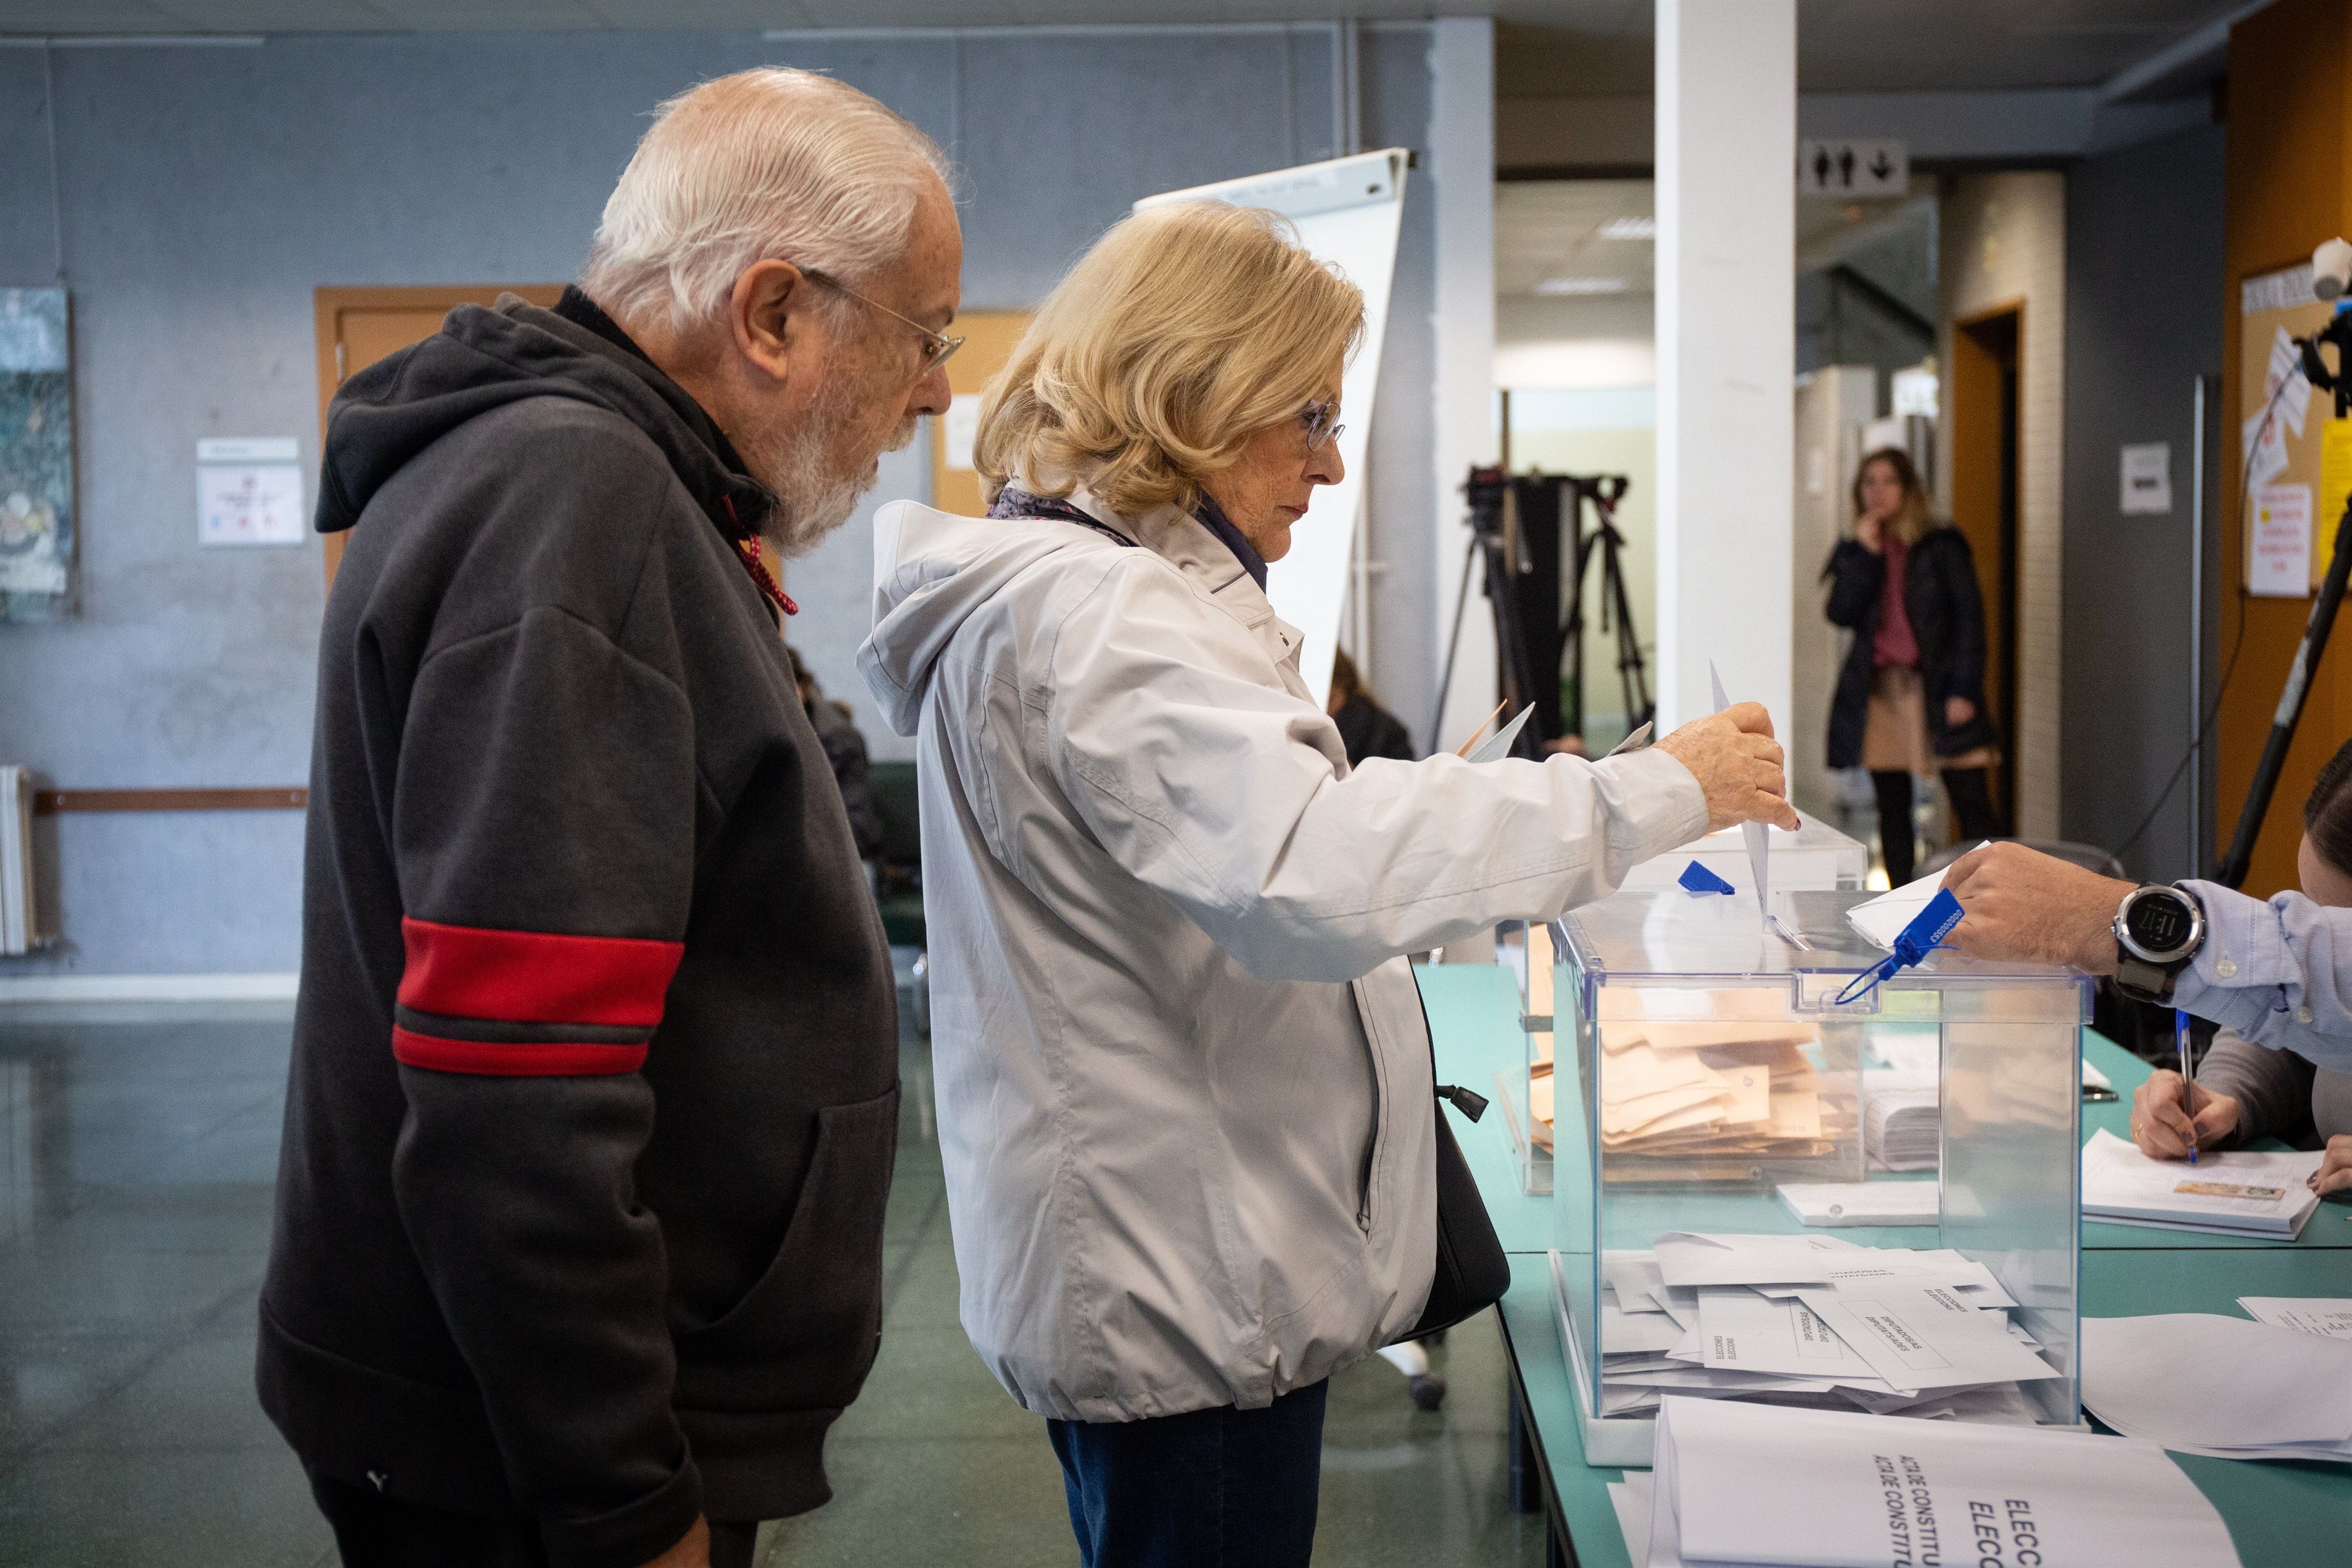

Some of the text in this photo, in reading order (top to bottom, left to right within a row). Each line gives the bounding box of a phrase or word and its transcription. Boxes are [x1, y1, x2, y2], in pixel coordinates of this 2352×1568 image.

[1930, 910, 1962, 943] 000200553
[1924, 1290, 1955, 1310] ELECCIONS
[1934, 1288, 1968, 1312] ELECCIONES
[1865, 1316, 1910, 1351] DIPUTATS/ADES
[1880, 1316, 1923, 1349] DIPUTADOS/AS
[1880, 1475, 1900, 1488] DE
[1906, 1474, 1927, 1486] DE
